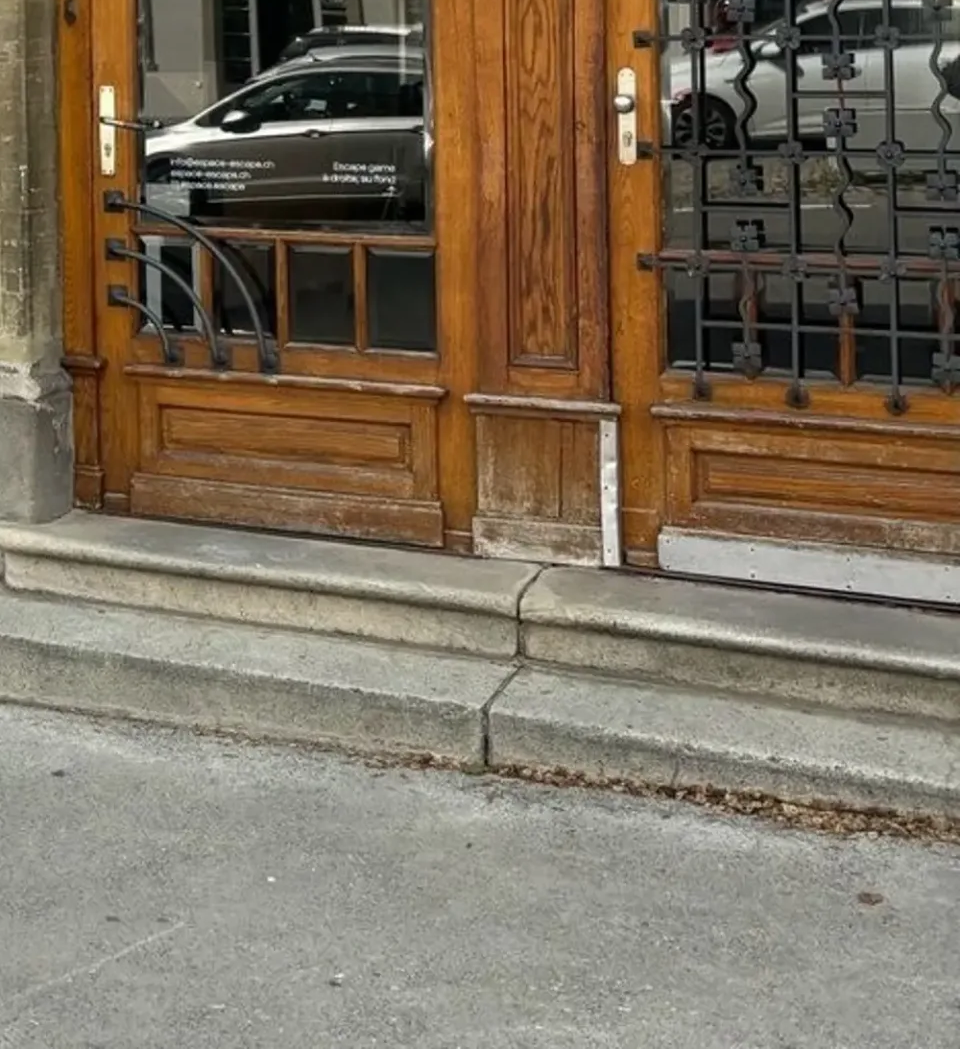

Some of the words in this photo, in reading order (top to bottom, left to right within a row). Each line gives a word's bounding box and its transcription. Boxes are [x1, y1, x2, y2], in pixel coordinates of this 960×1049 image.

[333, 161, 367, 172] Escape
[367, 163, 395, 173] game
[360, 175, 373, 183] au
[373, 174, 396, 184] fond
